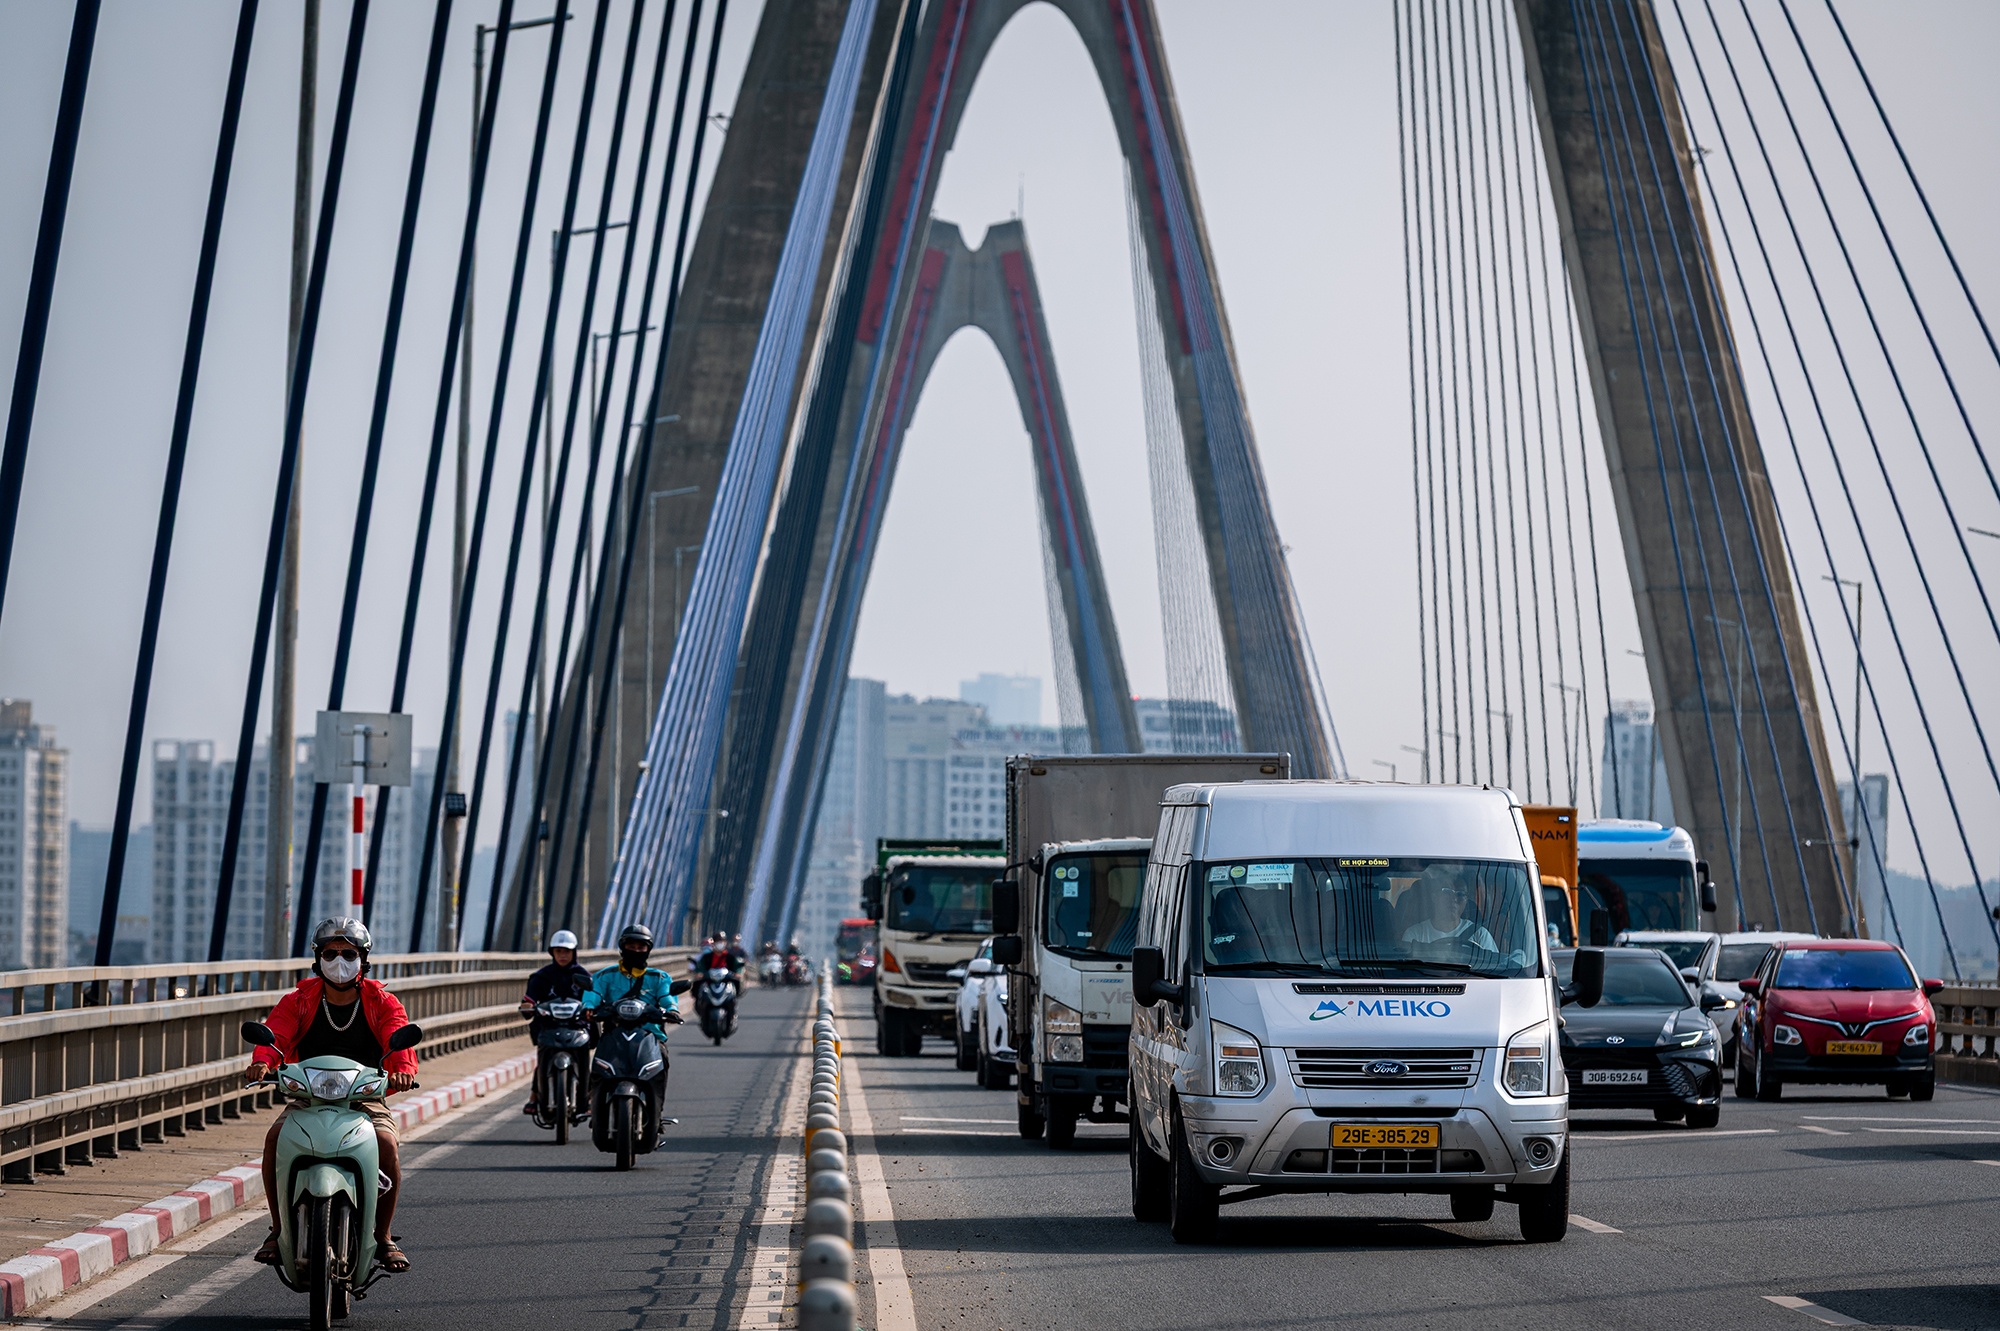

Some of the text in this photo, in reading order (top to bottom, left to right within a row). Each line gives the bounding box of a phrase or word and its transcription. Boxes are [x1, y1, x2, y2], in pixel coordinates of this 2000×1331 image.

[1531, 829, 1569, 840] NAM
[1357, 1000, 1451, 1018] MEIKO
[1373, 1062, 1399, 1074] Ford
[1588, 1072, 1643, 1083] 30B-692.64
[1341, 1129, 1430, 1144] 29E-385.29
